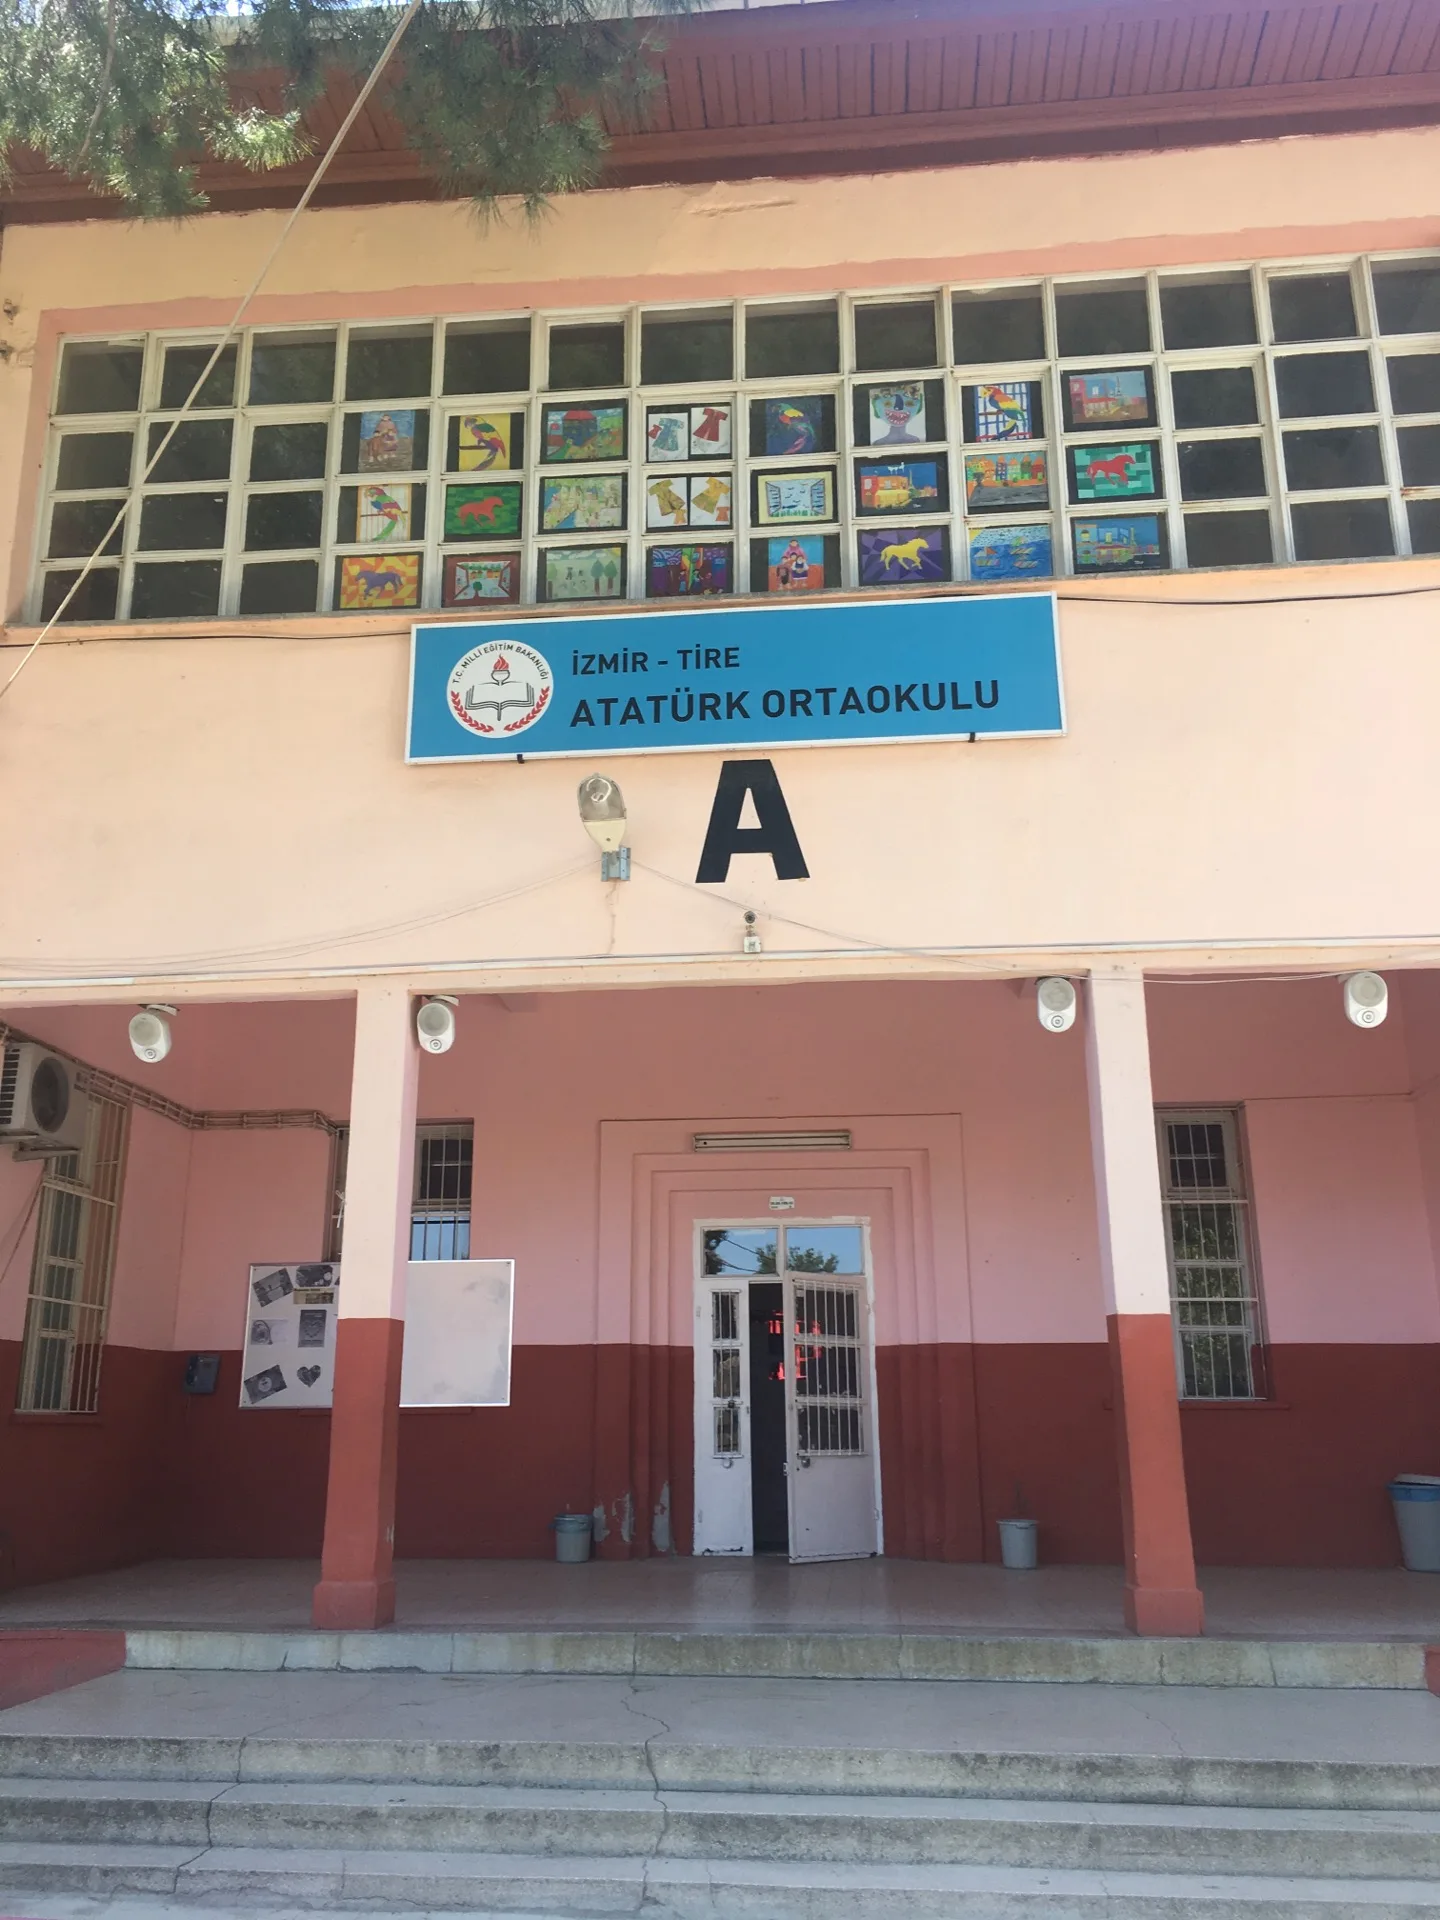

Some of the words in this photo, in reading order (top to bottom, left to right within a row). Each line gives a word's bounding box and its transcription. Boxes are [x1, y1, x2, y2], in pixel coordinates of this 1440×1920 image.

[452, 670, 464, 684] T.C.
[461, 650, 482, 668] MİLLİ
[484, 643, 513, 654] EĞİTİM
[515, 646, 548, 680] BAKANLIĞI
[572, 649, 648, 675] İZMİR
[676, 643, 740, 670] TİRE
[569, 687, 751, 727] ATATÜRK
[762, 679, 999, 719] ORTAOKULU
[695, 758, 811, 883] A
